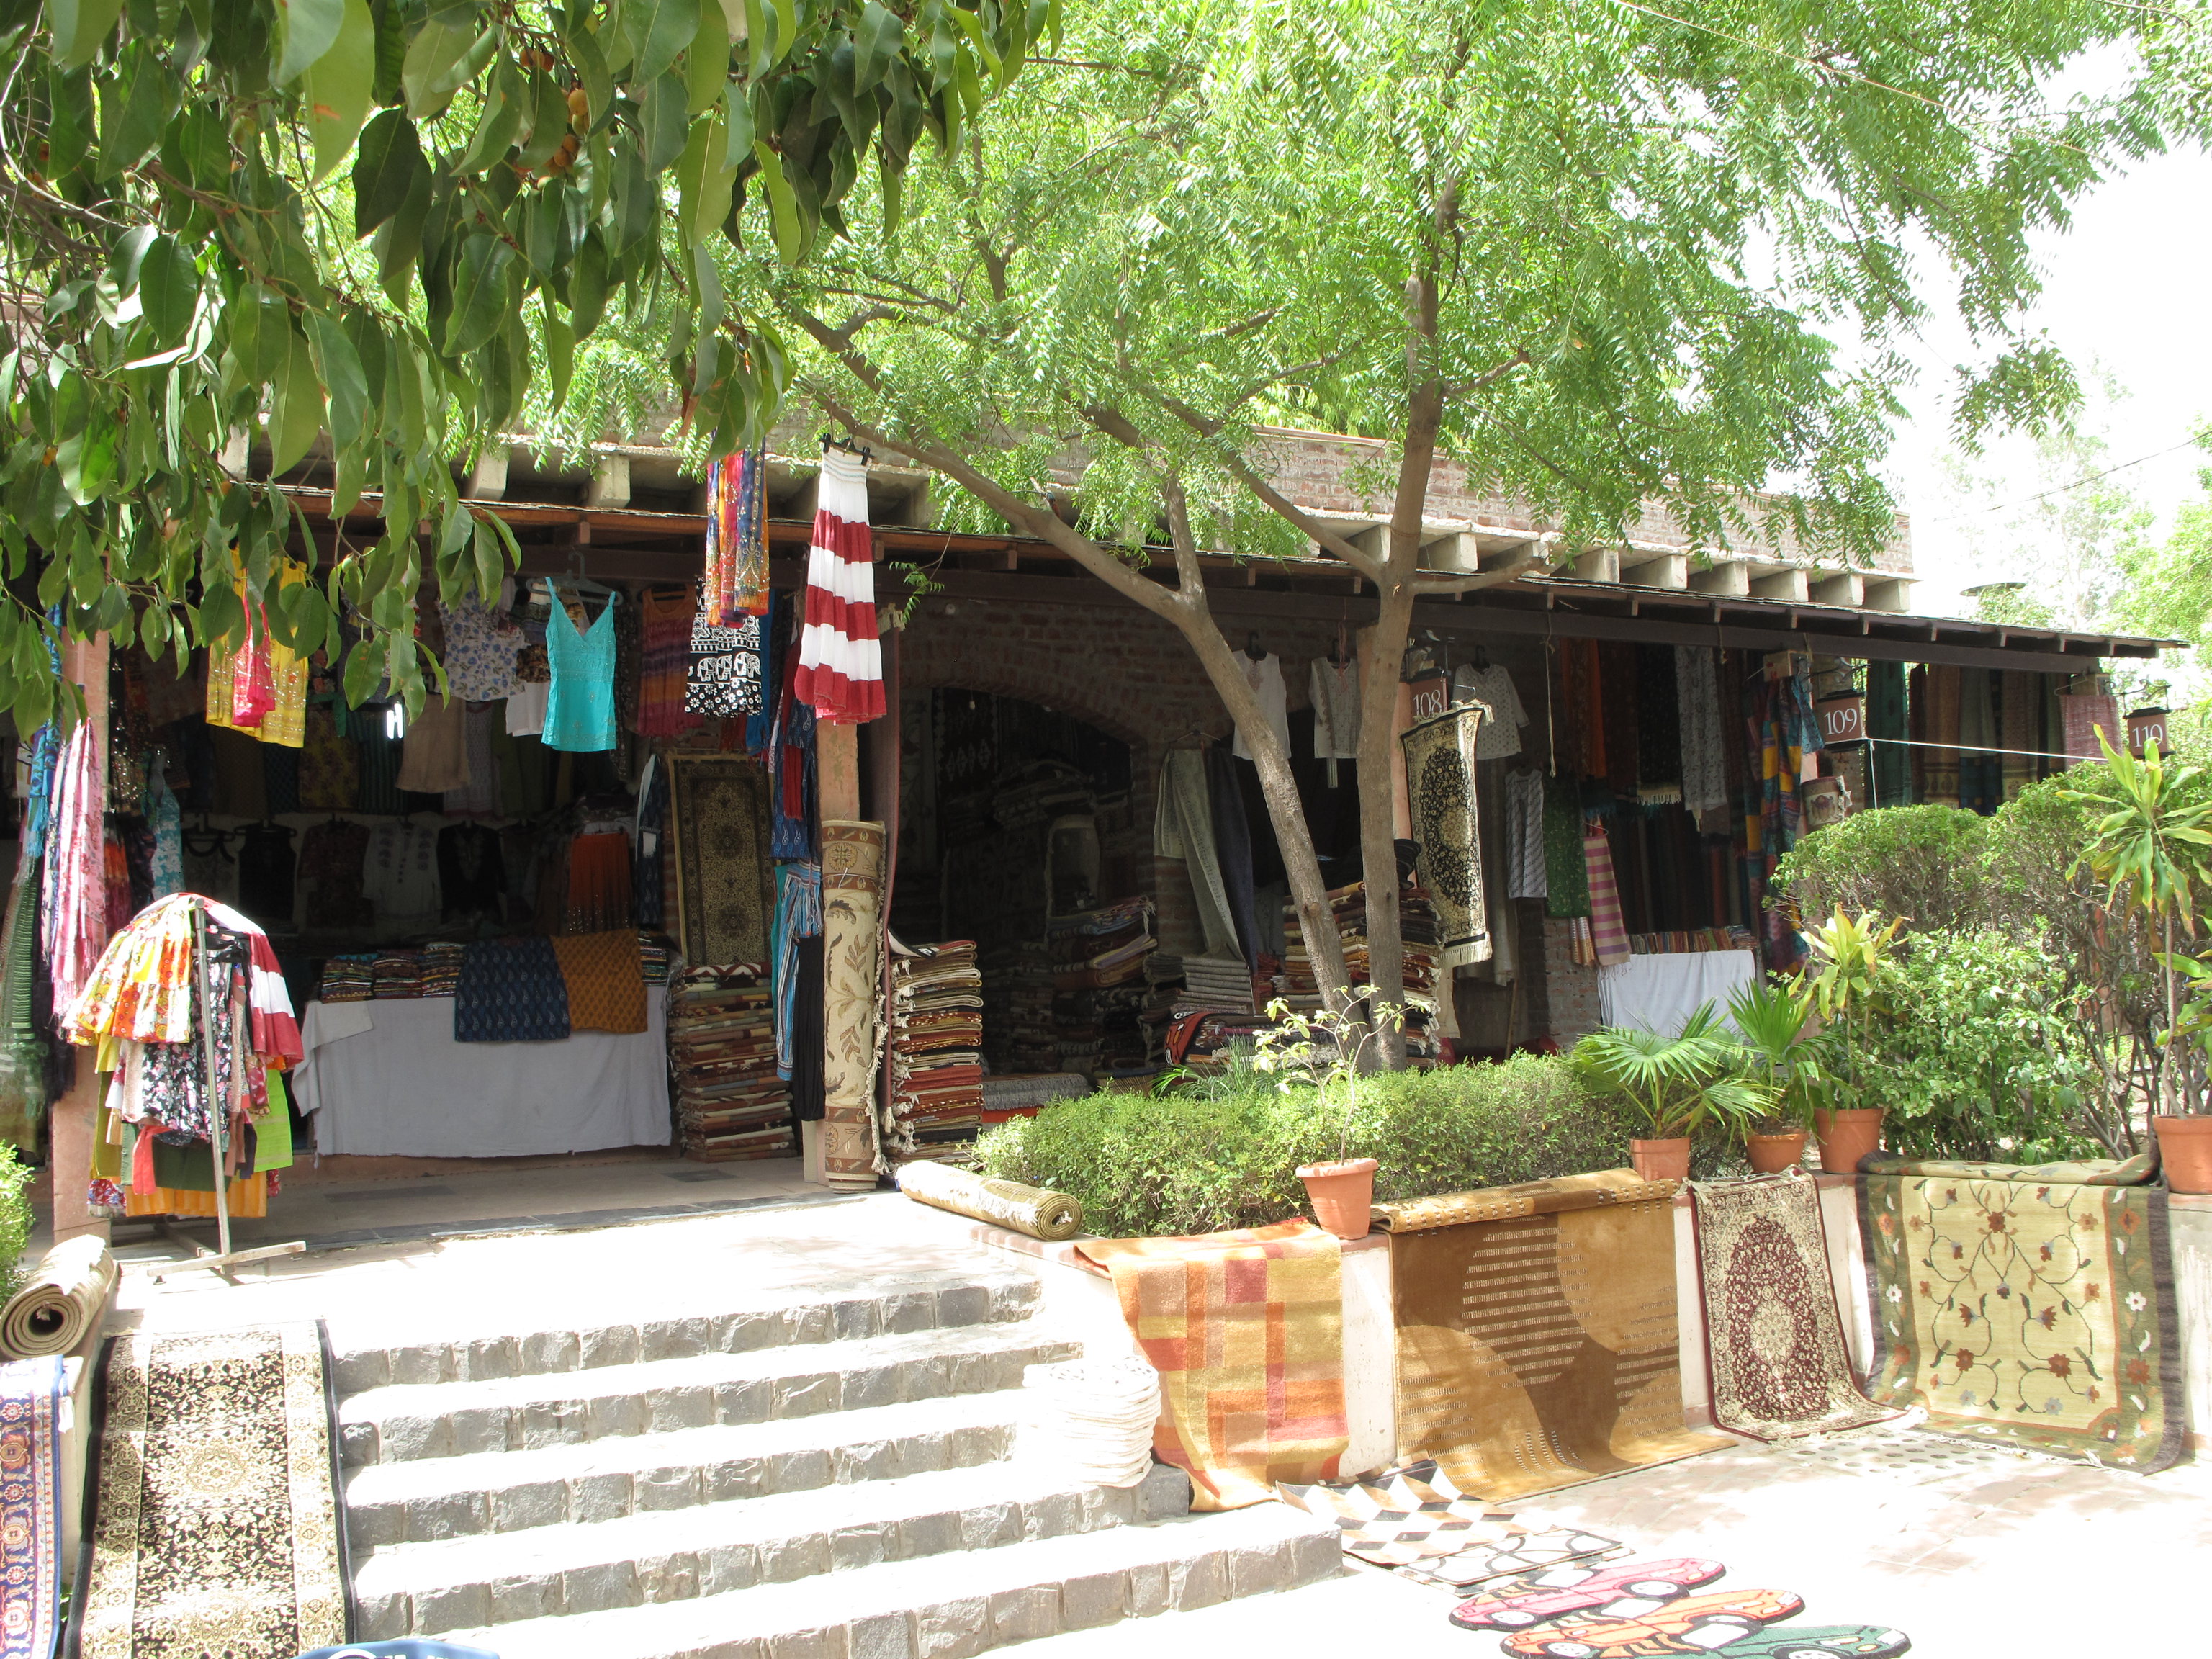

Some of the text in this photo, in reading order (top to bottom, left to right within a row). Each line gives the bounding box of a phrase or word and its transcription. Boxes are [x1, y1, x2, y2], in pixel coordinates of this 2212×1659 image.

[1413, 690, 1442, 719] 108
[1824, 708, 1858, 735] 109
[2132, 724, 2163, 747] 110
